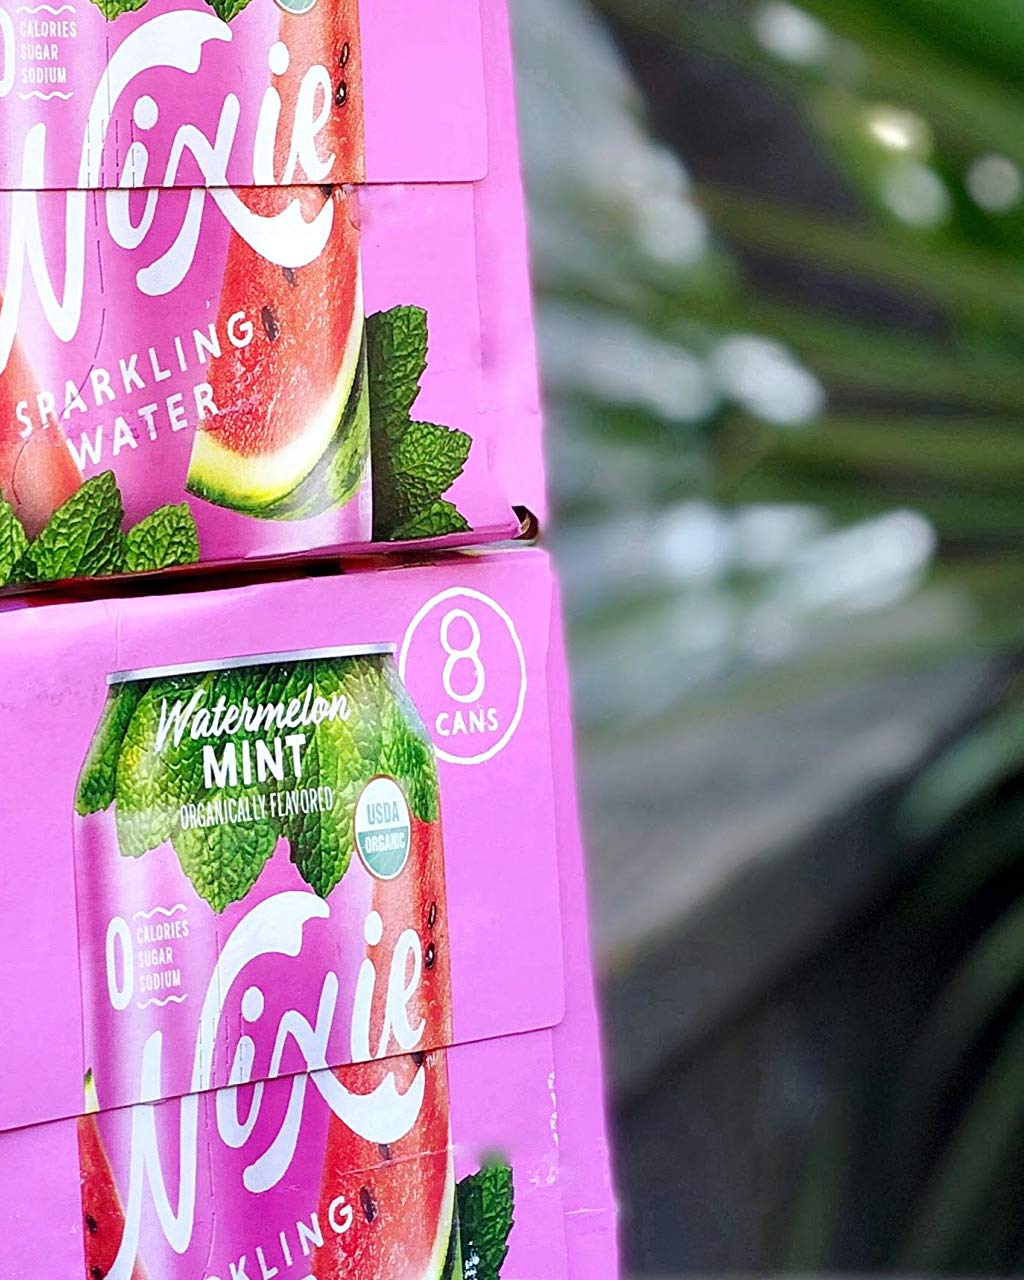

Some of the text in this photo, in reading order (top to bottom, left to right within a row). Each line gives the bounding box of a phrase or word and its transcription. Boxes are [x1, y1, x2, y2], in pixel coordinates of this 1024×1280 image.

[19, 21, 78, 38] CALORIES
[20, 44, 59, 61] SUGAR
[20, 67, 67, 85] SODIUM
[16, 310, 254, 438] SPARKLING
[66, 382, 219, 472] WATER
[439, 608, 485, 703] 8
[155, 683, 352, 752] Watermelon
[435, 707, 500, 737] CANS
[202, 733, 306, 790] MINT
[180, 786, 333, 830] ORGANICALLY FLAVORED
[366, 801, 400, 823] USDA
[364, 831, 406, 854] ORGANIC
[136, 919, 190, 944] CALORIES
[105, 916, 134, 1011] 0
[137, 949, 173, 969] SUGAR
[138, 972, 182, 994] SODIUM
[99, 890, 426, 1280] Nixie
[204, 1195, 353, 1280] KLING
